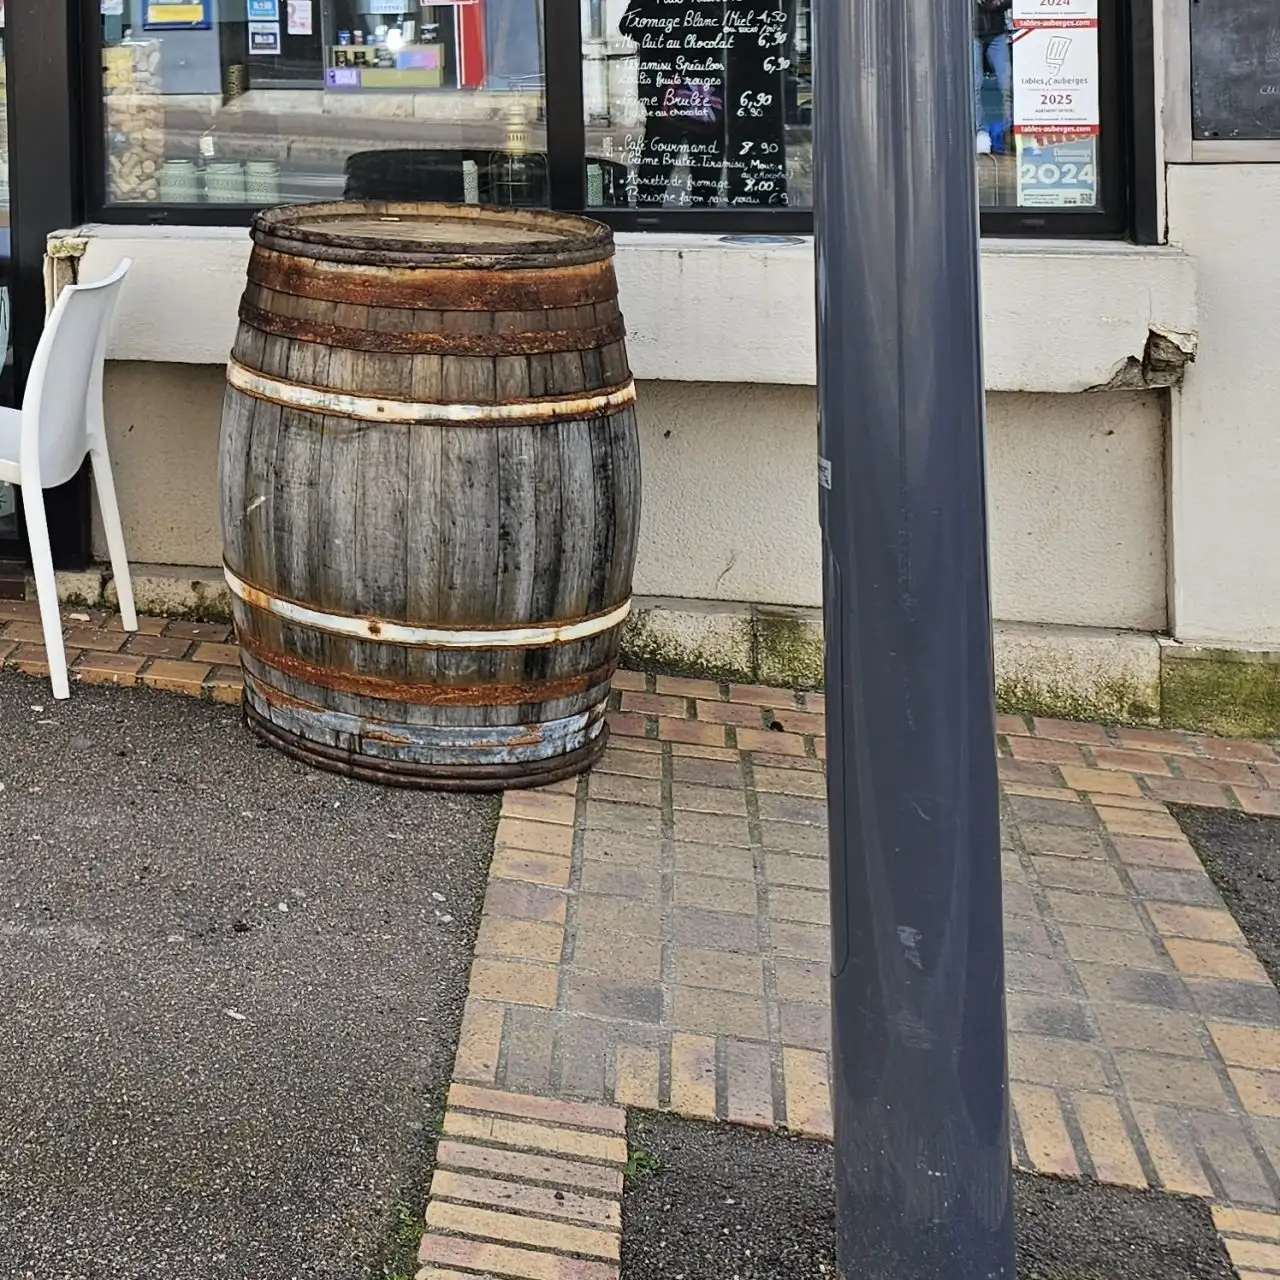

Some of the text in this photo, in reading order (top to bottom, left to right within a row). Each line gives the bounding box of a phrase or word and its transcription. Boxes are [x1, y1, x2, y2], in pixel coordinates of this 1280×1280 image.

[622, 8, 680, 33] Fromage
[683, 10, 719, 27] Blanc
[1020, 19, 1091, 28] tables-auberges.com
[642, 33, 666, 49] Cuit
[666, 38, 681, 48] au
[684, 33, 735, 49] Chocolat
[656, 72, 682, 88] fruits
[683, 77, 722, 91] rouges
[1021, 77, 1044, 85] tables
[1053, 77, 1089, 86] auberges
[1040, 94, 1073, 106] 2025
[669, 108, 709, 117] chocolat
[1020, 125, 1092, 134] tables-auberges.com
[650, 137, 719, 154] Gourmand
[1020, 163, 1095, 185] 2024
[671, 175, 683, 186] de
[686, 174, 732, 194] fromage
